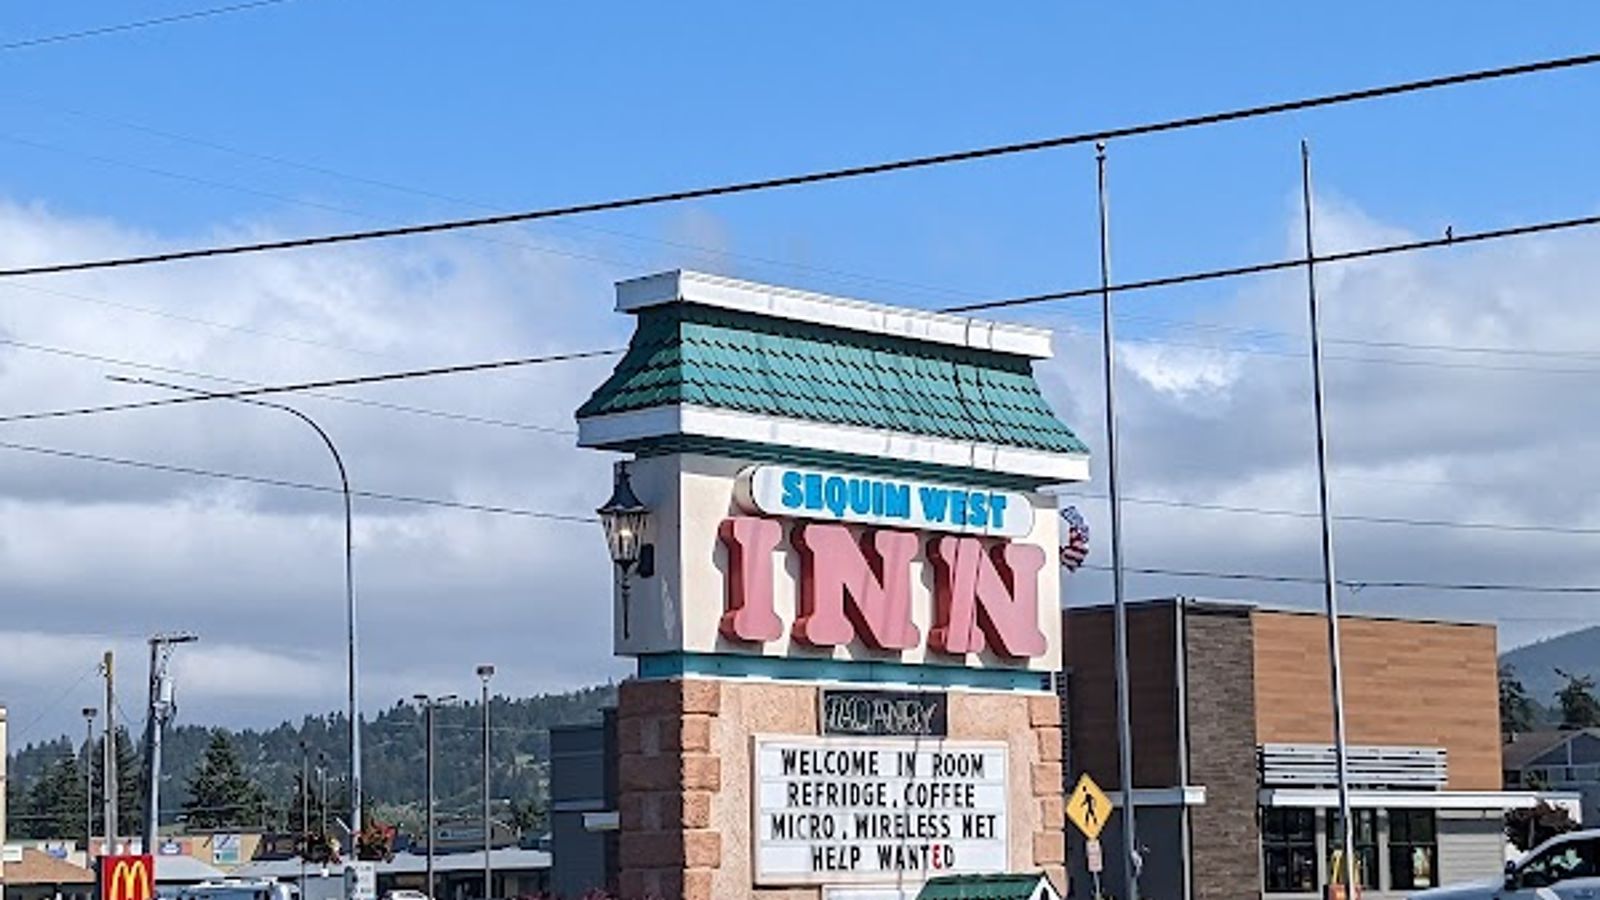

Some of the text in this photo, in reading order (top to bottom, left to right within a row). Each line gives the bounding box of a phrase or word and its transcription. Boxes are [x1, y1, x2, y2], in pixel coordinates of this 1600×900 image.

[781, 471, 1007, 528] SEQUIM WEST
[718, 517, 1047, 657] INN
[781, 749, 985, 778] WELCOME IN ROOM
[962, 815, 997, 838] NET
[812, 844, 955, 871] HELP WANTED
